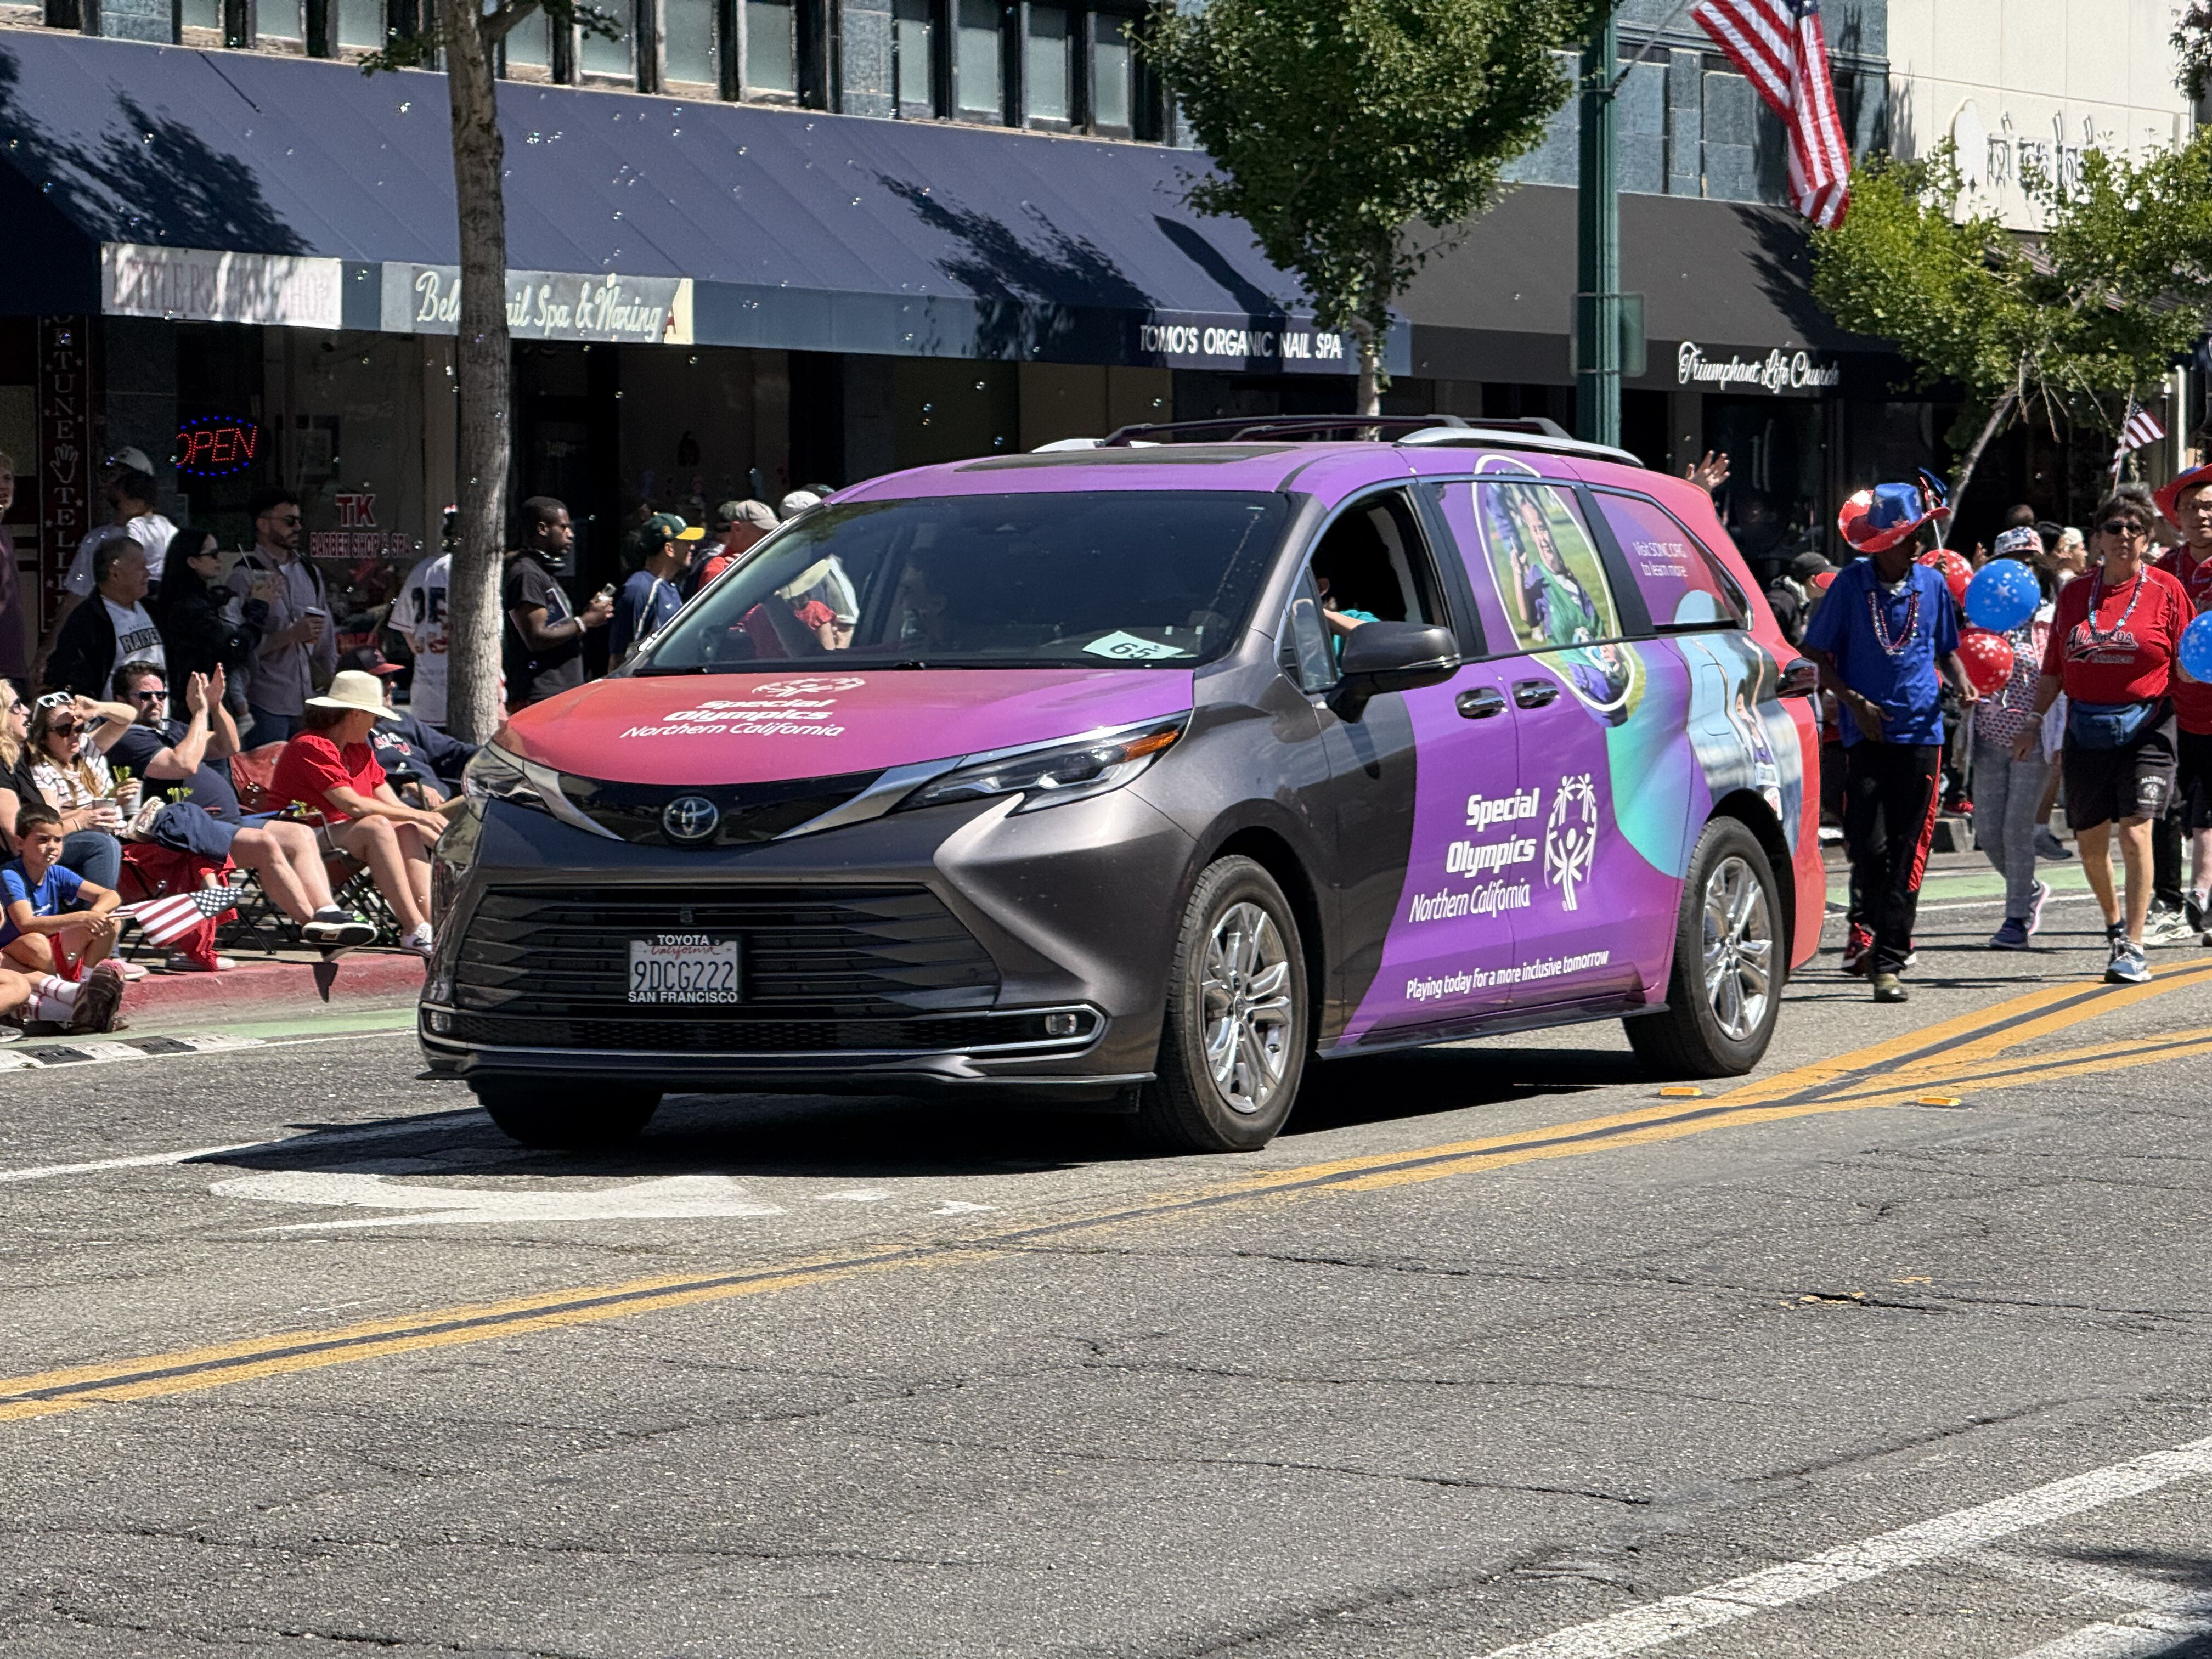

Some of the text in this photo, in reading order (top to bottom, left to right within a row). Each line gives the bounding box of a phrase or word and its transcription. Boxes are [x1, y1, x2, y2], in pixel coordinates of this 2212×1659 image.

[415, 270, 663, 343] Bel ail Spa & Waxing
[1141, 325, 1342, 359] TOMO'S ORGANIC NAIL SPA
[1679, 341, 1839, 394] Triumphant Life Church
[335, 494, 376, 527] TK
[310, 531, 350, 558] BARBER
[352, 532, 379, 558] SHOP
[1109, 642, 1158, 658] 65
[662, 709, 833, 723] Olympics
[696, 699, 838, 709] Special
[619, 722, 846, 738] Northern California
[1466, 787, 1541, 832] Special
[1446, 833, 1538, 878] Olympics
[1409, 877, 1531, 923] Northern California
[651, 945, 720, 960] California
[657, 935, 710, 946] TOYOTA
[633, 961, 734, 990] 9DCG222
[1406, 950, 1610, 1002] Playing today for a more inclusive tomorrow
[628, 991, 738, 1003] SAN FRANCISCO
